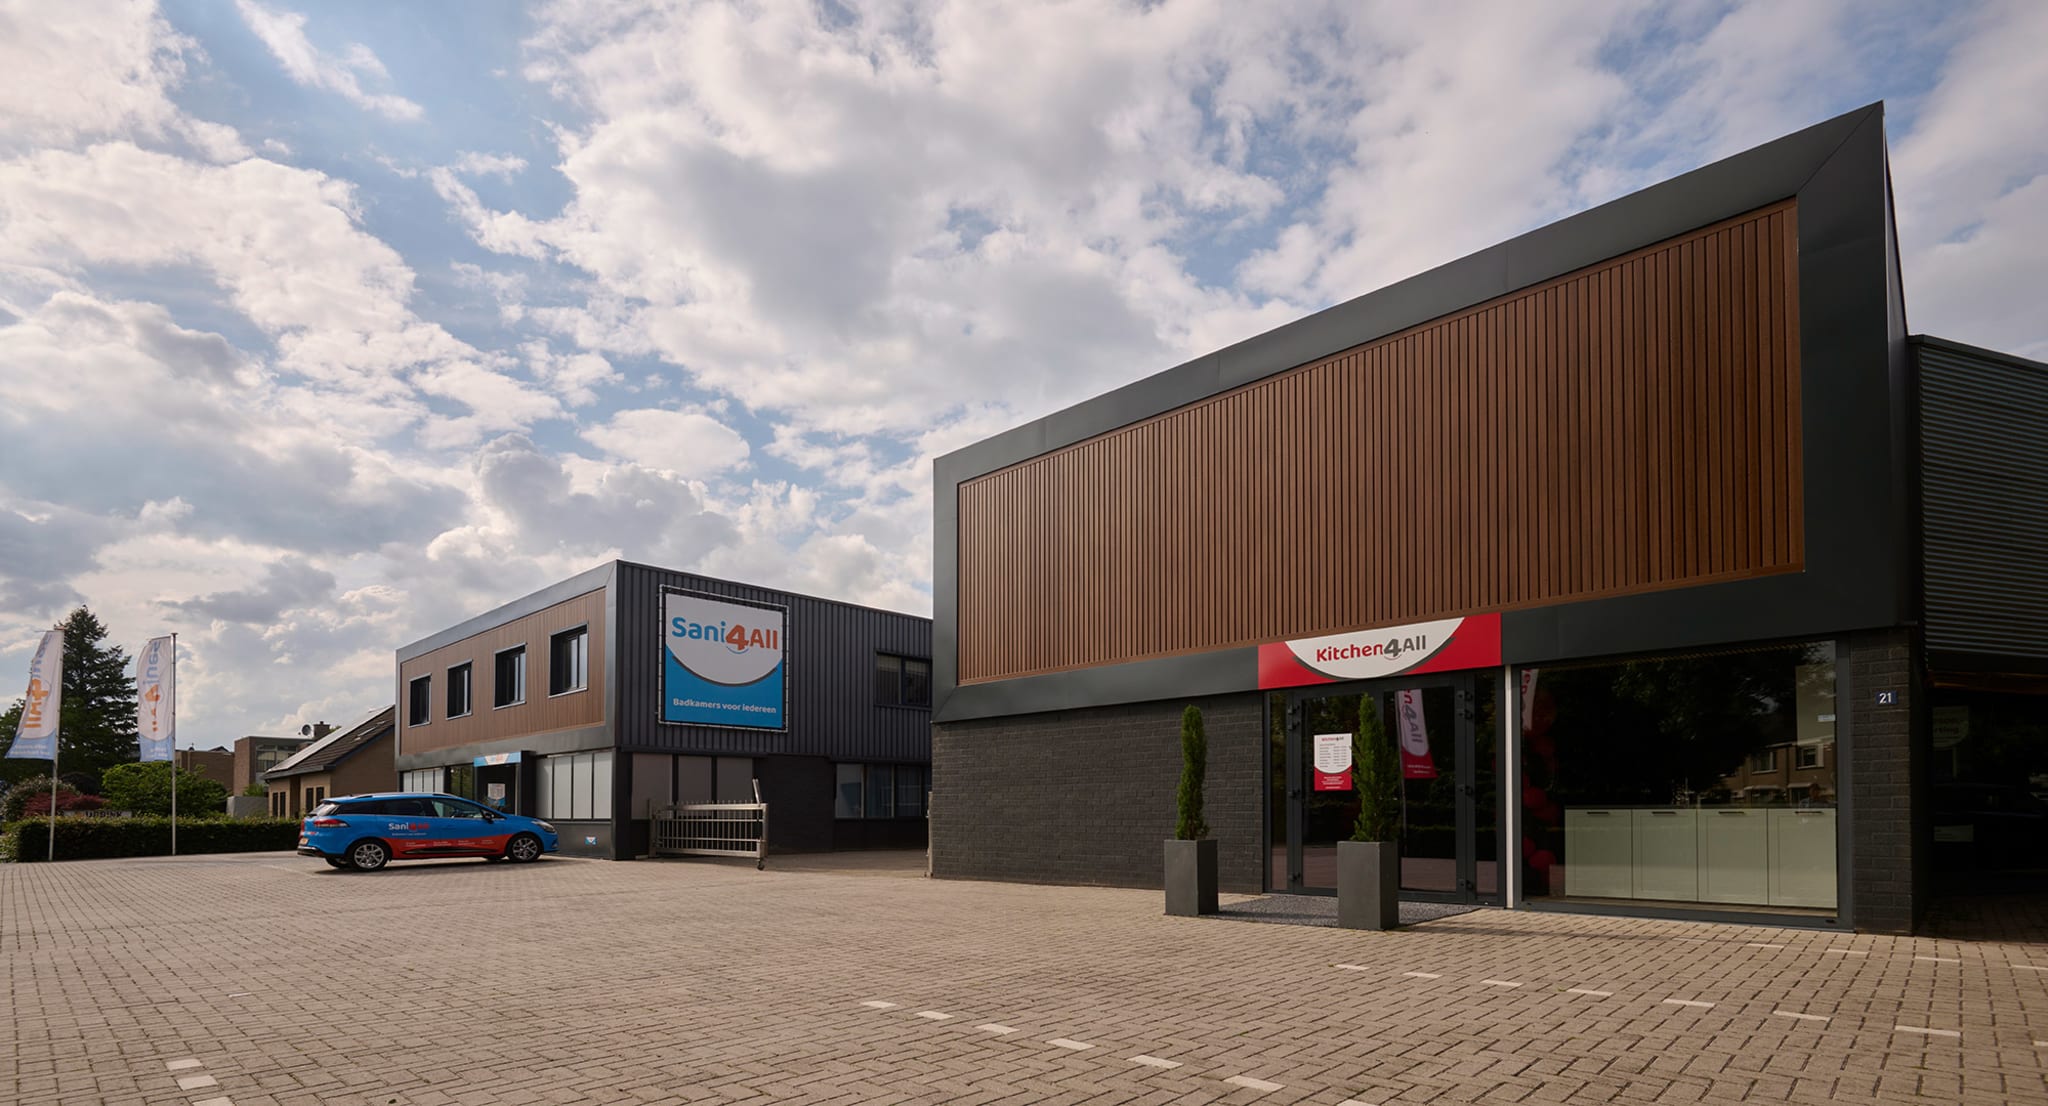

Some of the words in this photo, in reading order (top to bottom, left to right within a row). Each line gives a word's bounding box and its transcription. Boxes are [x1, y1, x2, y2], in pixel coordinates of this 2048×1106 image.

[672, 617, 778, 651] Sani4All
[1316, 635, 1426, 662] Kitchen4All
[673, 698, 720, 709] Badkamers
[742, 704, 776, 713] iedereen
[1879, 692, 1892, 704] 21
